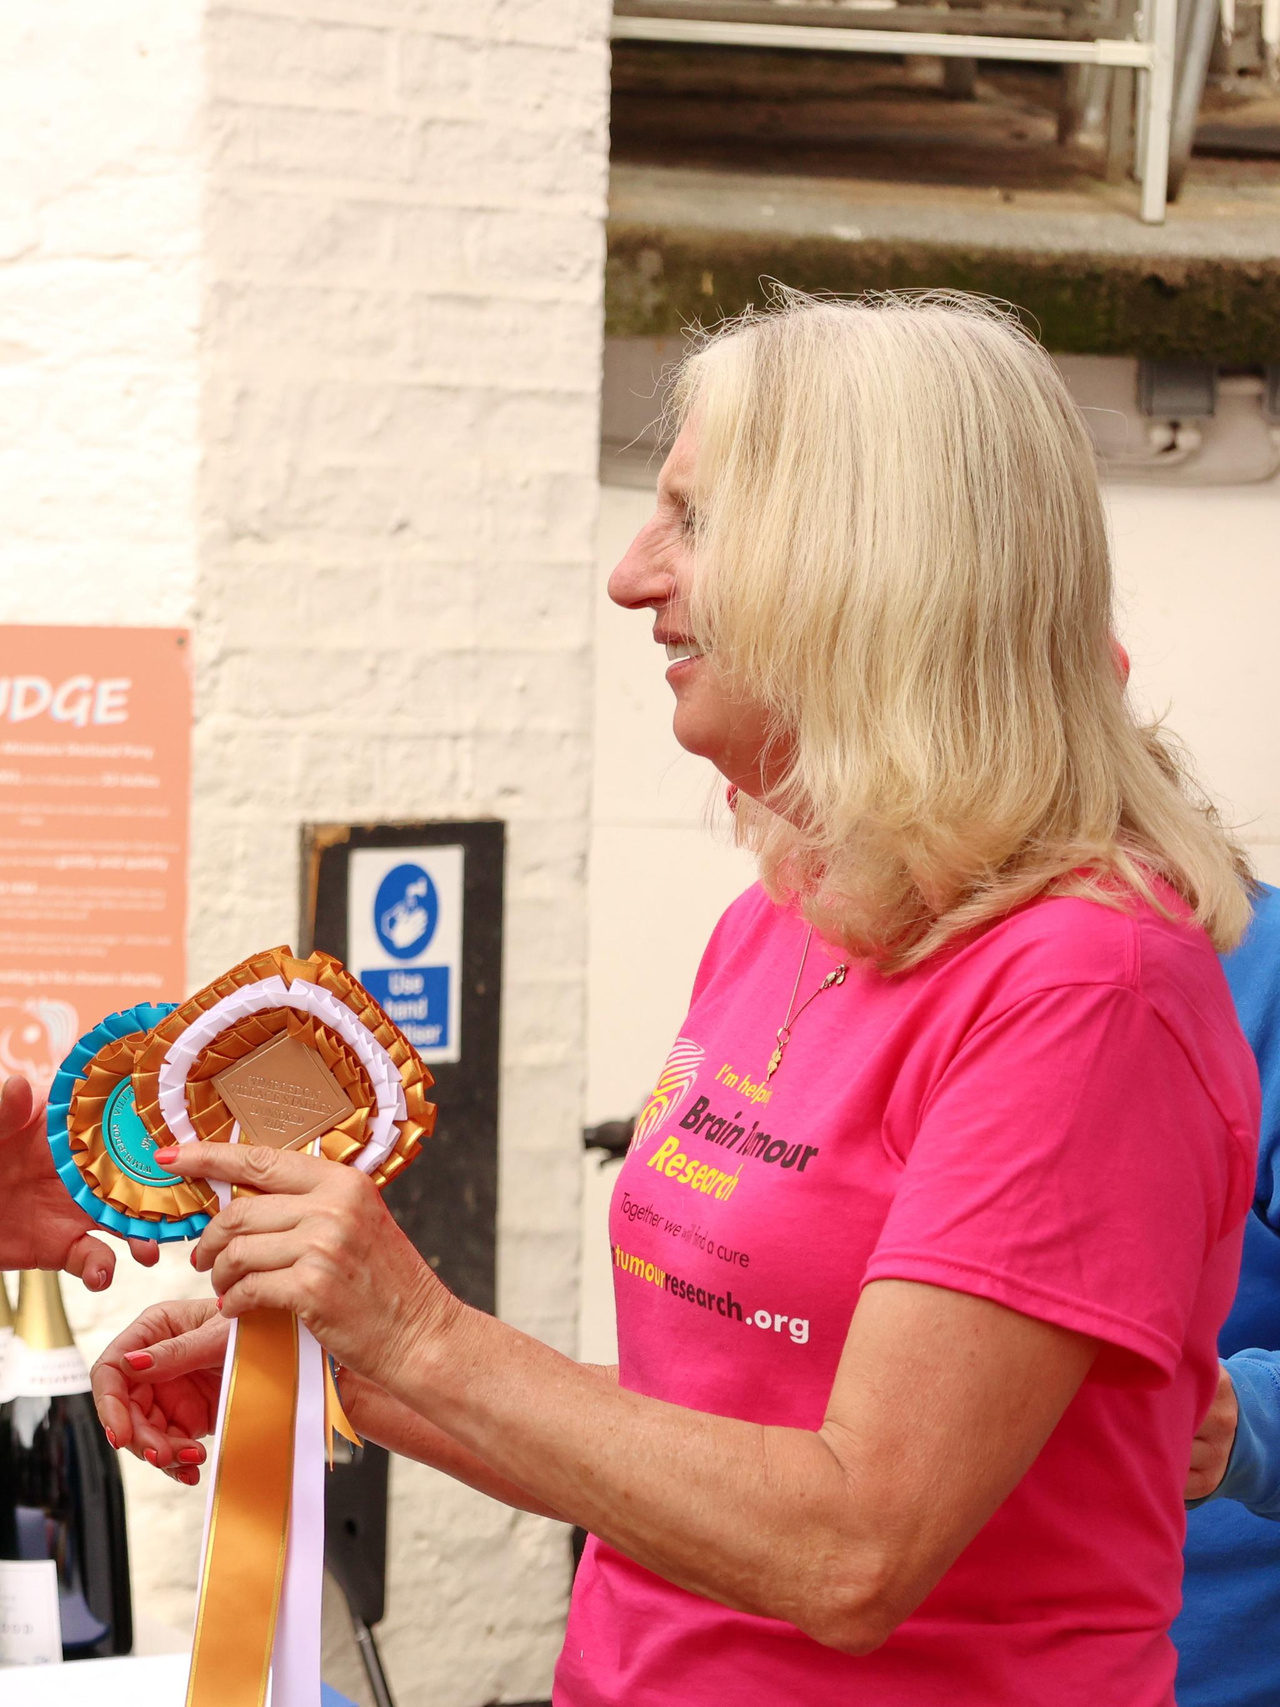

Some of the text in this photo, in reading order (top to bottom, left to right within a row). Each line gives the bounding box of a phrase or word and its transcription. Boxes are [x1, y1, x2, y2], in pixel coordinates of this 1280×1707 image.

[388, 970, 424, 996] Use
[383, 996, 428, 1021] hand
[714, 1063, 739, 1088] I'm
[679, 1095, 745, 1149] Brain
[647, 1135, 744, 1201] Research
[620, 1192, 664, 1228] Together
[664, 1220, 682, 1237] we
[717, 1245, 750, 1268] cure
